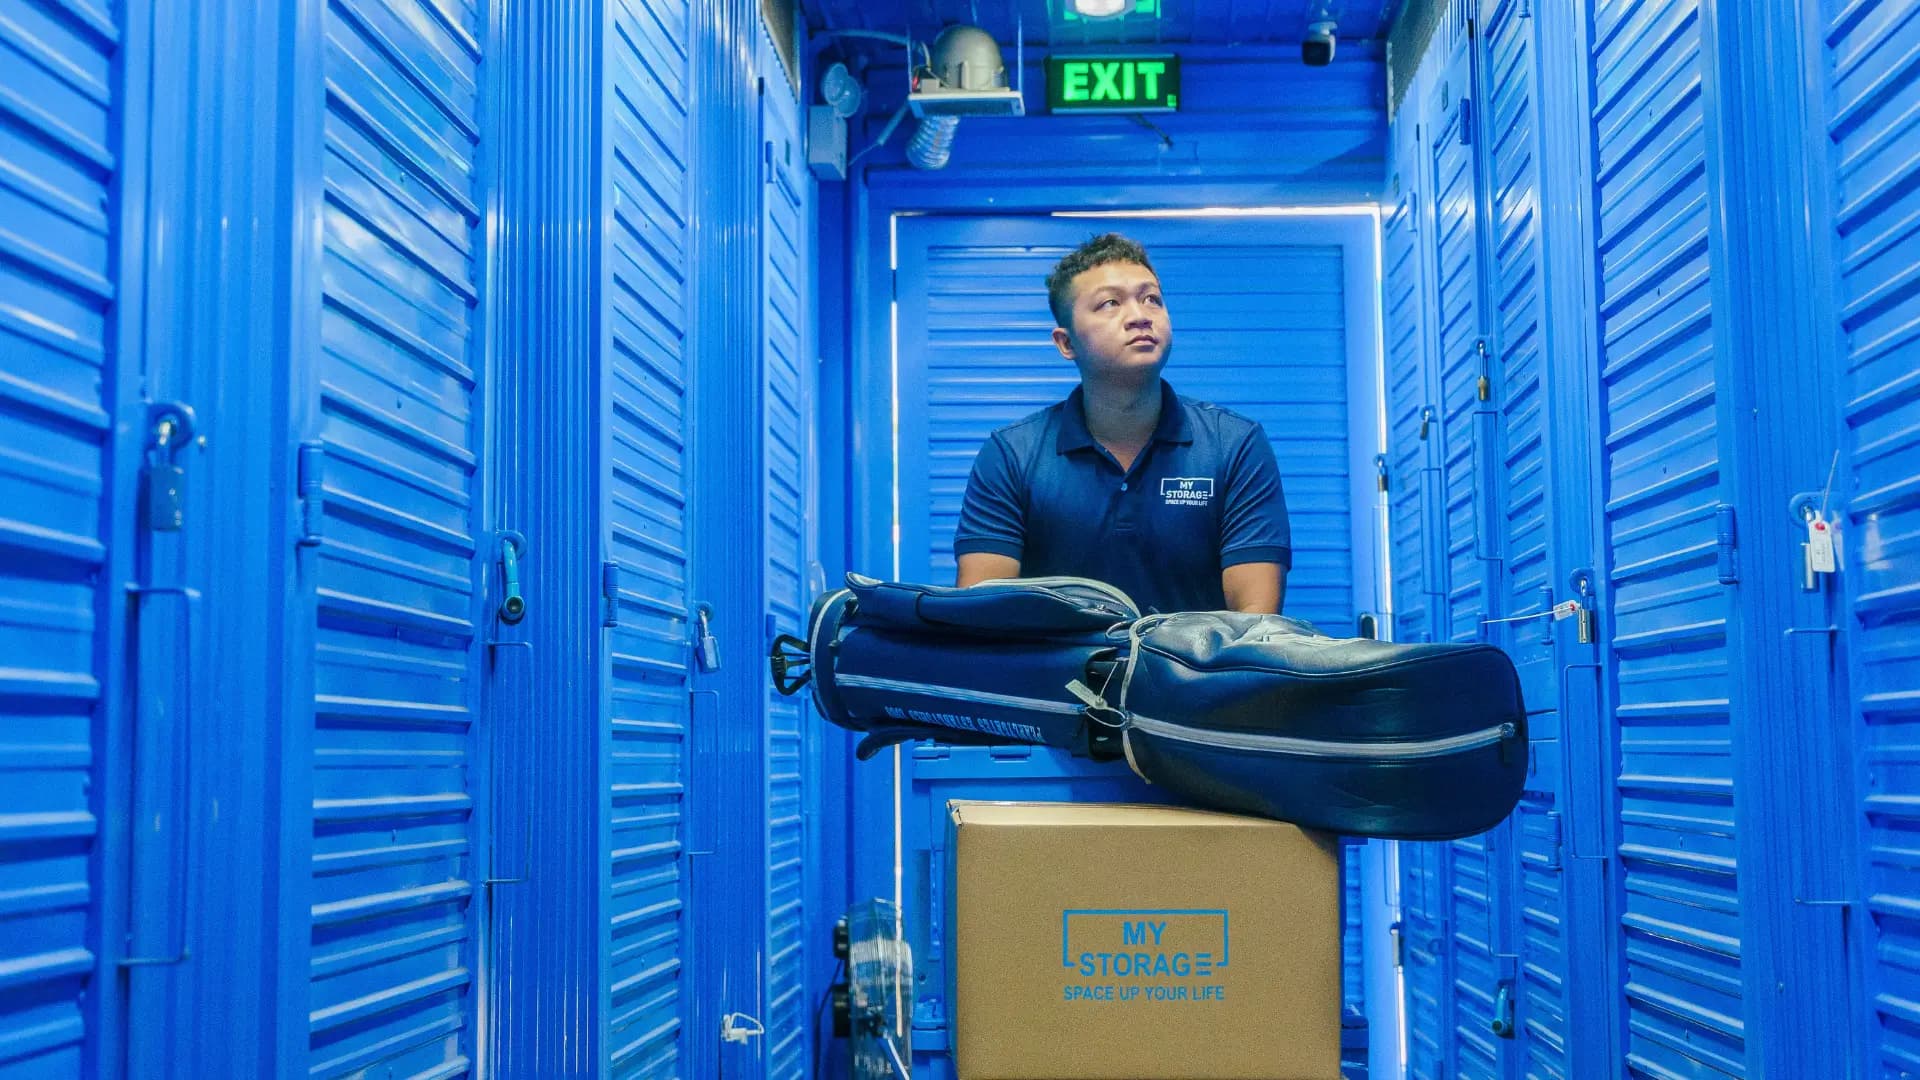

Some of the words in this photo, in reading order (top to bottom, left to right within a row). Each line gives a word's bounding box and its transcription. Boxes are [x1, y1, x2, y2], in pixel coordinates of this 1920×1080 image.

[1063, 62, 1165, 101] EXIT
[1165, 490, 1209, 500] STORAGE
[1179, 481, 1194, 490] MY
[1122, 921, 1168, 946] MY
[1079, 952, 1212, 977] STORAGE
[1063, 986, 1114, 1001] SPACE
[1119, 986, 1140, 1001] UP
[1145, 986, 1188, 1001] YOUR
[1192, 986, 1225, 1001] LIFE
